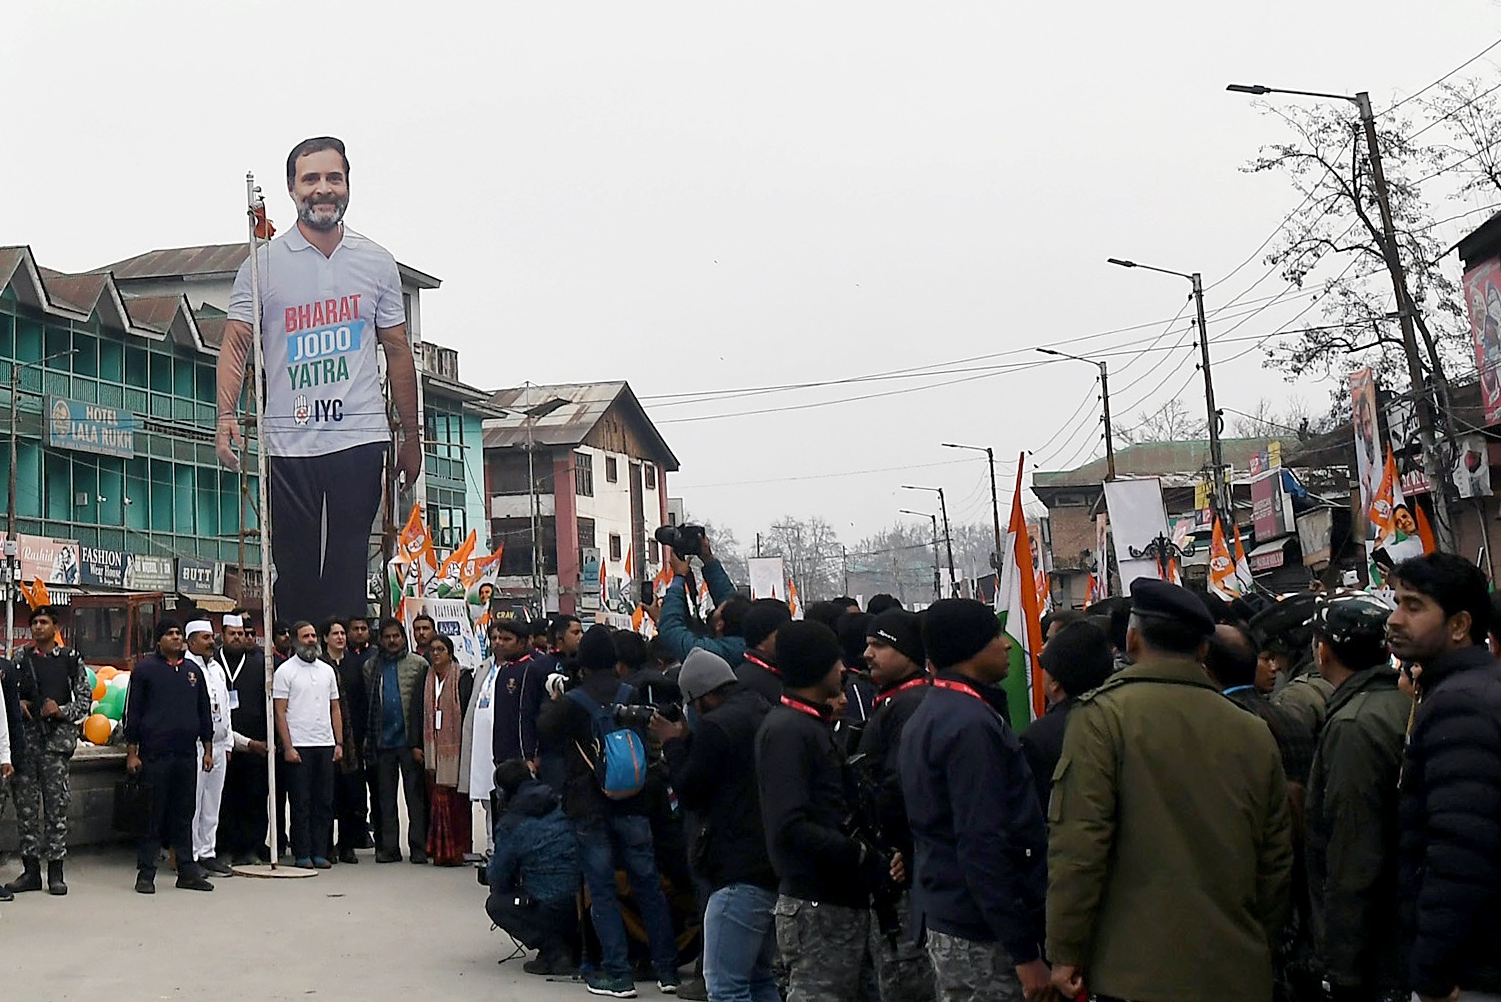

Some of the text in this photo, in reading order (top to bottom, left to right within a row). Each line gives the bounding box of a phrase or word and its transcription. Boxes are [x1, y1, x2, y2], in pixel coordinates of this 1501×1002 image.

[285, 294, 362, 333] BHARAT
[294, 326, 351, 360] JODO
[287, 356, 350, 390] YATRA
[86, 406, 118, 426] HOTEL
[314, 399, 343, 422] IYC
[72, 421, 98, 444] LALA
[102, 428, 132, 450] RUKH
[22, 546, 54, 562] Rashid
[82, 547, 122, 566] FASHION
[182, 567, 212, 582] BUTT
